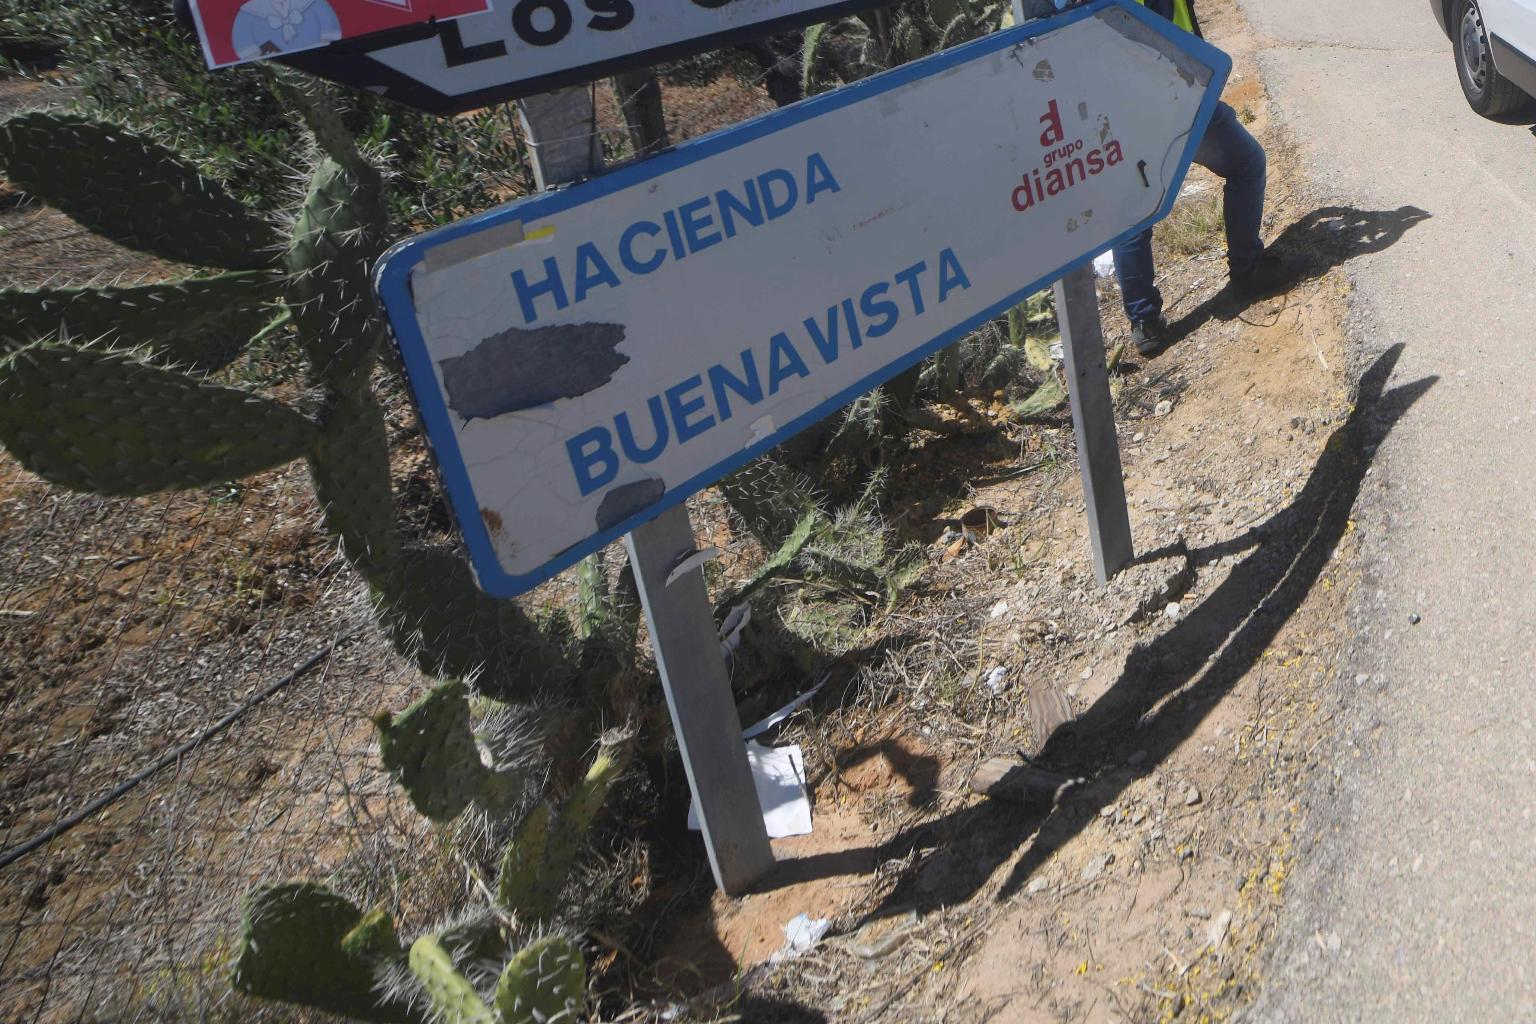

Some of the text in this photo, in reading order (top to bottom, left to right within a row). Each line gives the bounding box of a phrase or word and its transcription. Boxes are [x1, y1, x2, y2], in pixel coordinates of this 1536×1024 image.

[1011, 140, 1124, 211] diansa
[1044, 139, 1083, 168] grupo
[510, 153, 842, 323] HACIENDA
[565, 248, 971, 497] BUENAVISTA
